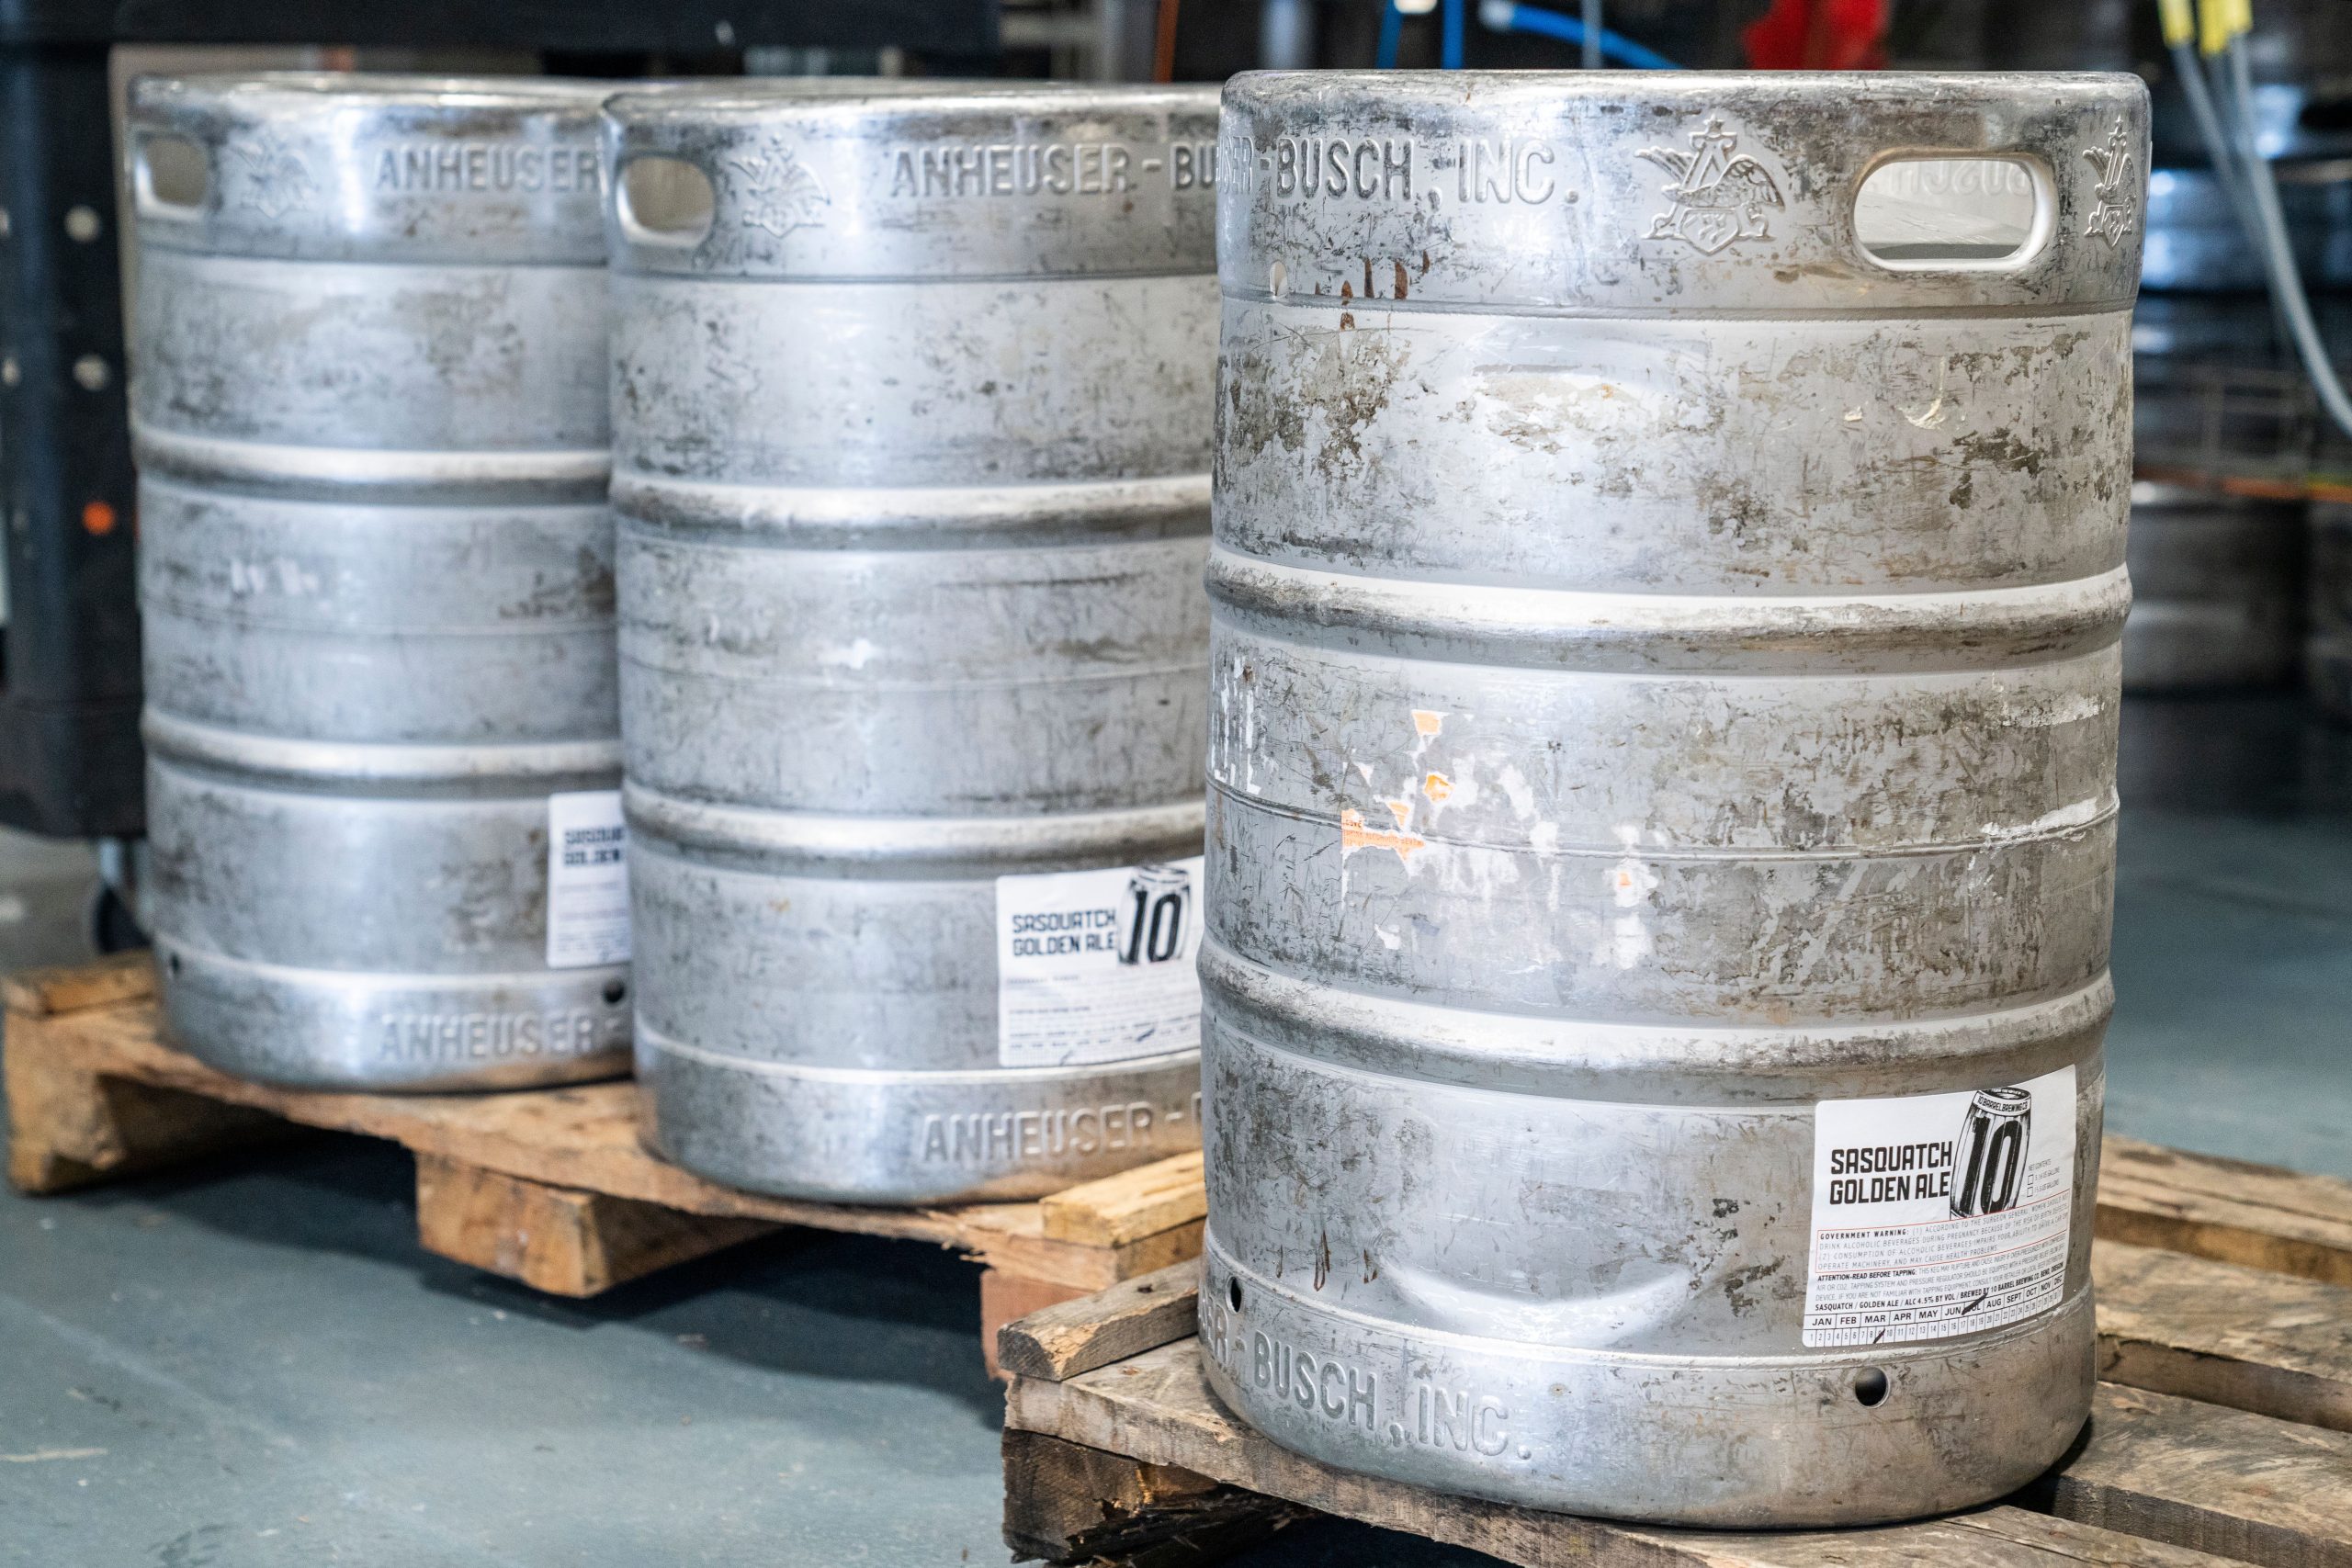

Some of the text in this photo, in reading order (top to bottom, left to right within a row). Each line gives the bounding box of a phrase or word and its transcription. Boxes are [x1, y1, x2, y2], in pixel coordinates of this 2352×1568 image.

[375, 143, 598, 192] ANHEUSER
[1458, 139, 1579, 204] INC.
[1012, 908, 1116, 933] SASQUATCH
[1127, 889, 1182, 964] 10
[1013, 931, 1115, 957] GOLDEN ALE
[1983, 1098, 2002, 1111] BARREL
[1830, 1141, 1953, 1175] SASQUATCH
[1953, 1115, 2023, 1217] 10
[1829, 1171, 1950, 1205] GOLDEN ALE
[1821, 1231, 1870, 1241] GOVERNMENT
[1874, 1228, 1909, 1237] WARNING:
[1926, 1223, 1960, 1234] ACCORDING
[1962, 1221, 1969, 1229] TO
[1972, 1219, 1981, 1227] THE
[1984, 1213, 2006, 1224] SURGEON
[1834, 1250, 1883, 1260] CONSUMPTION
[1900, 1246, 1934, 1256] ALCOHOLIC
[1939, 1240, 1972, 1252] BEVERAGES
[1973, 1235, 1996, 1247] IMPAIRS
[1998, 1232, 2011, 1242] YOUR
[2032, 1224, 2037, 1232] TO
[1843, 1240, 1880, 1249] ALCOHOLIC
[1883, 1237, 1919, 1247] BEVERAGES
[1923, 1235, 1945, 1244] DURING
[1948, 1229, 1979, 1240] PREGNANCY
[1982, 1224, 2003, 1235] BECAUSE
[2023, 1215, 2032, 1224] RISK
[1818, 1262, 1849, 1270] OPERATE
[1911, 1257, 1922, 1265] MAY
[1926, 1255, 1943, 1263] CAUSE
[1947, 1251, 1968, 1260] HEALTH
[1818, 1273, 1867, 1281] ATTENTION-READ
[1893, 1269, 1917, 1278] TAPPING:
[1952, 1262, 1970, 1271] RUPTURE
[1909, 1277, 1934, 1286] PRESSURE
[1937, 1273, 1962, 1283] REGULATOR
[1964, 1269, 1981, 1279] SHOULD
[1815, 1303, 1853, 1311] SASQUATCH
[1860, 1301, 1884, 1309] GOLDEN
[1905, 1298, 1916, 1306] ALC
[1918, 1296, 1934, 1304] 4.5%
[1945, 1293, 1955, 1302] VOL
[1961, 1289, 1982, 1300] BREWED
[1992, 1285, 1996, 1293] 10
[1998, 1280, 2015, 1292] BARREL
[2016, 1274, 2033, 1286] BREWING
[1841, 1316, 1857, 1325] FEB
[1894, 1314, 1912, 1322] APR
[1919, 1311, 1938, 1319] MAY
[1945, 1307, 1961, 1316] JUN
[1987, 1298, 2002, 1309] AUG
[2007, 1292, 2021, 1303] SEPT
[2027, 1287, 2037, 1297] OCT
[2041, 1280, 2052, 1292] NOV
[2054, 1275, 2063, 1285] DEC
[1883, 1290, 1906, 1298] FAMILIAR
[1909, 1288, 1920, 1296] WITH
[1924, 1286, 1943, 1294] TAPPING
[1973, 1277, 1991, 1288] CONSULT
[1819, 1333, 1823, 1341] 2
[1853, 1331, 1857, 1339] 6
[1870, 1330, 1873, 1338] 8
[1887, 1329, 1893, 1337] 10
[1898, 1328, 1904, 1337] 11
[1909, 1327, 1915, 1336] 12
[1920, 1326, 1926, 1335] 13
[1931, 1325, 1936, 1334] 14
[1941, 1324, 1947, 1332] 15
[1951, 1323, 1956, 1331] 16
[1961, 1321, 1966, 1329] 17
[1970, 1319, 1975, 1327] 18
[1979, 1317, 1984, 1325] 19
[1986, 1315, 1992, 1324] 20
[1996, 1314, 2000, 1322] 21
[2003, 1311, 2007, 1320] 22
[2011, 1309, 2016, 1317] 23
[1419, 1383, 1532, 1461] INC.
